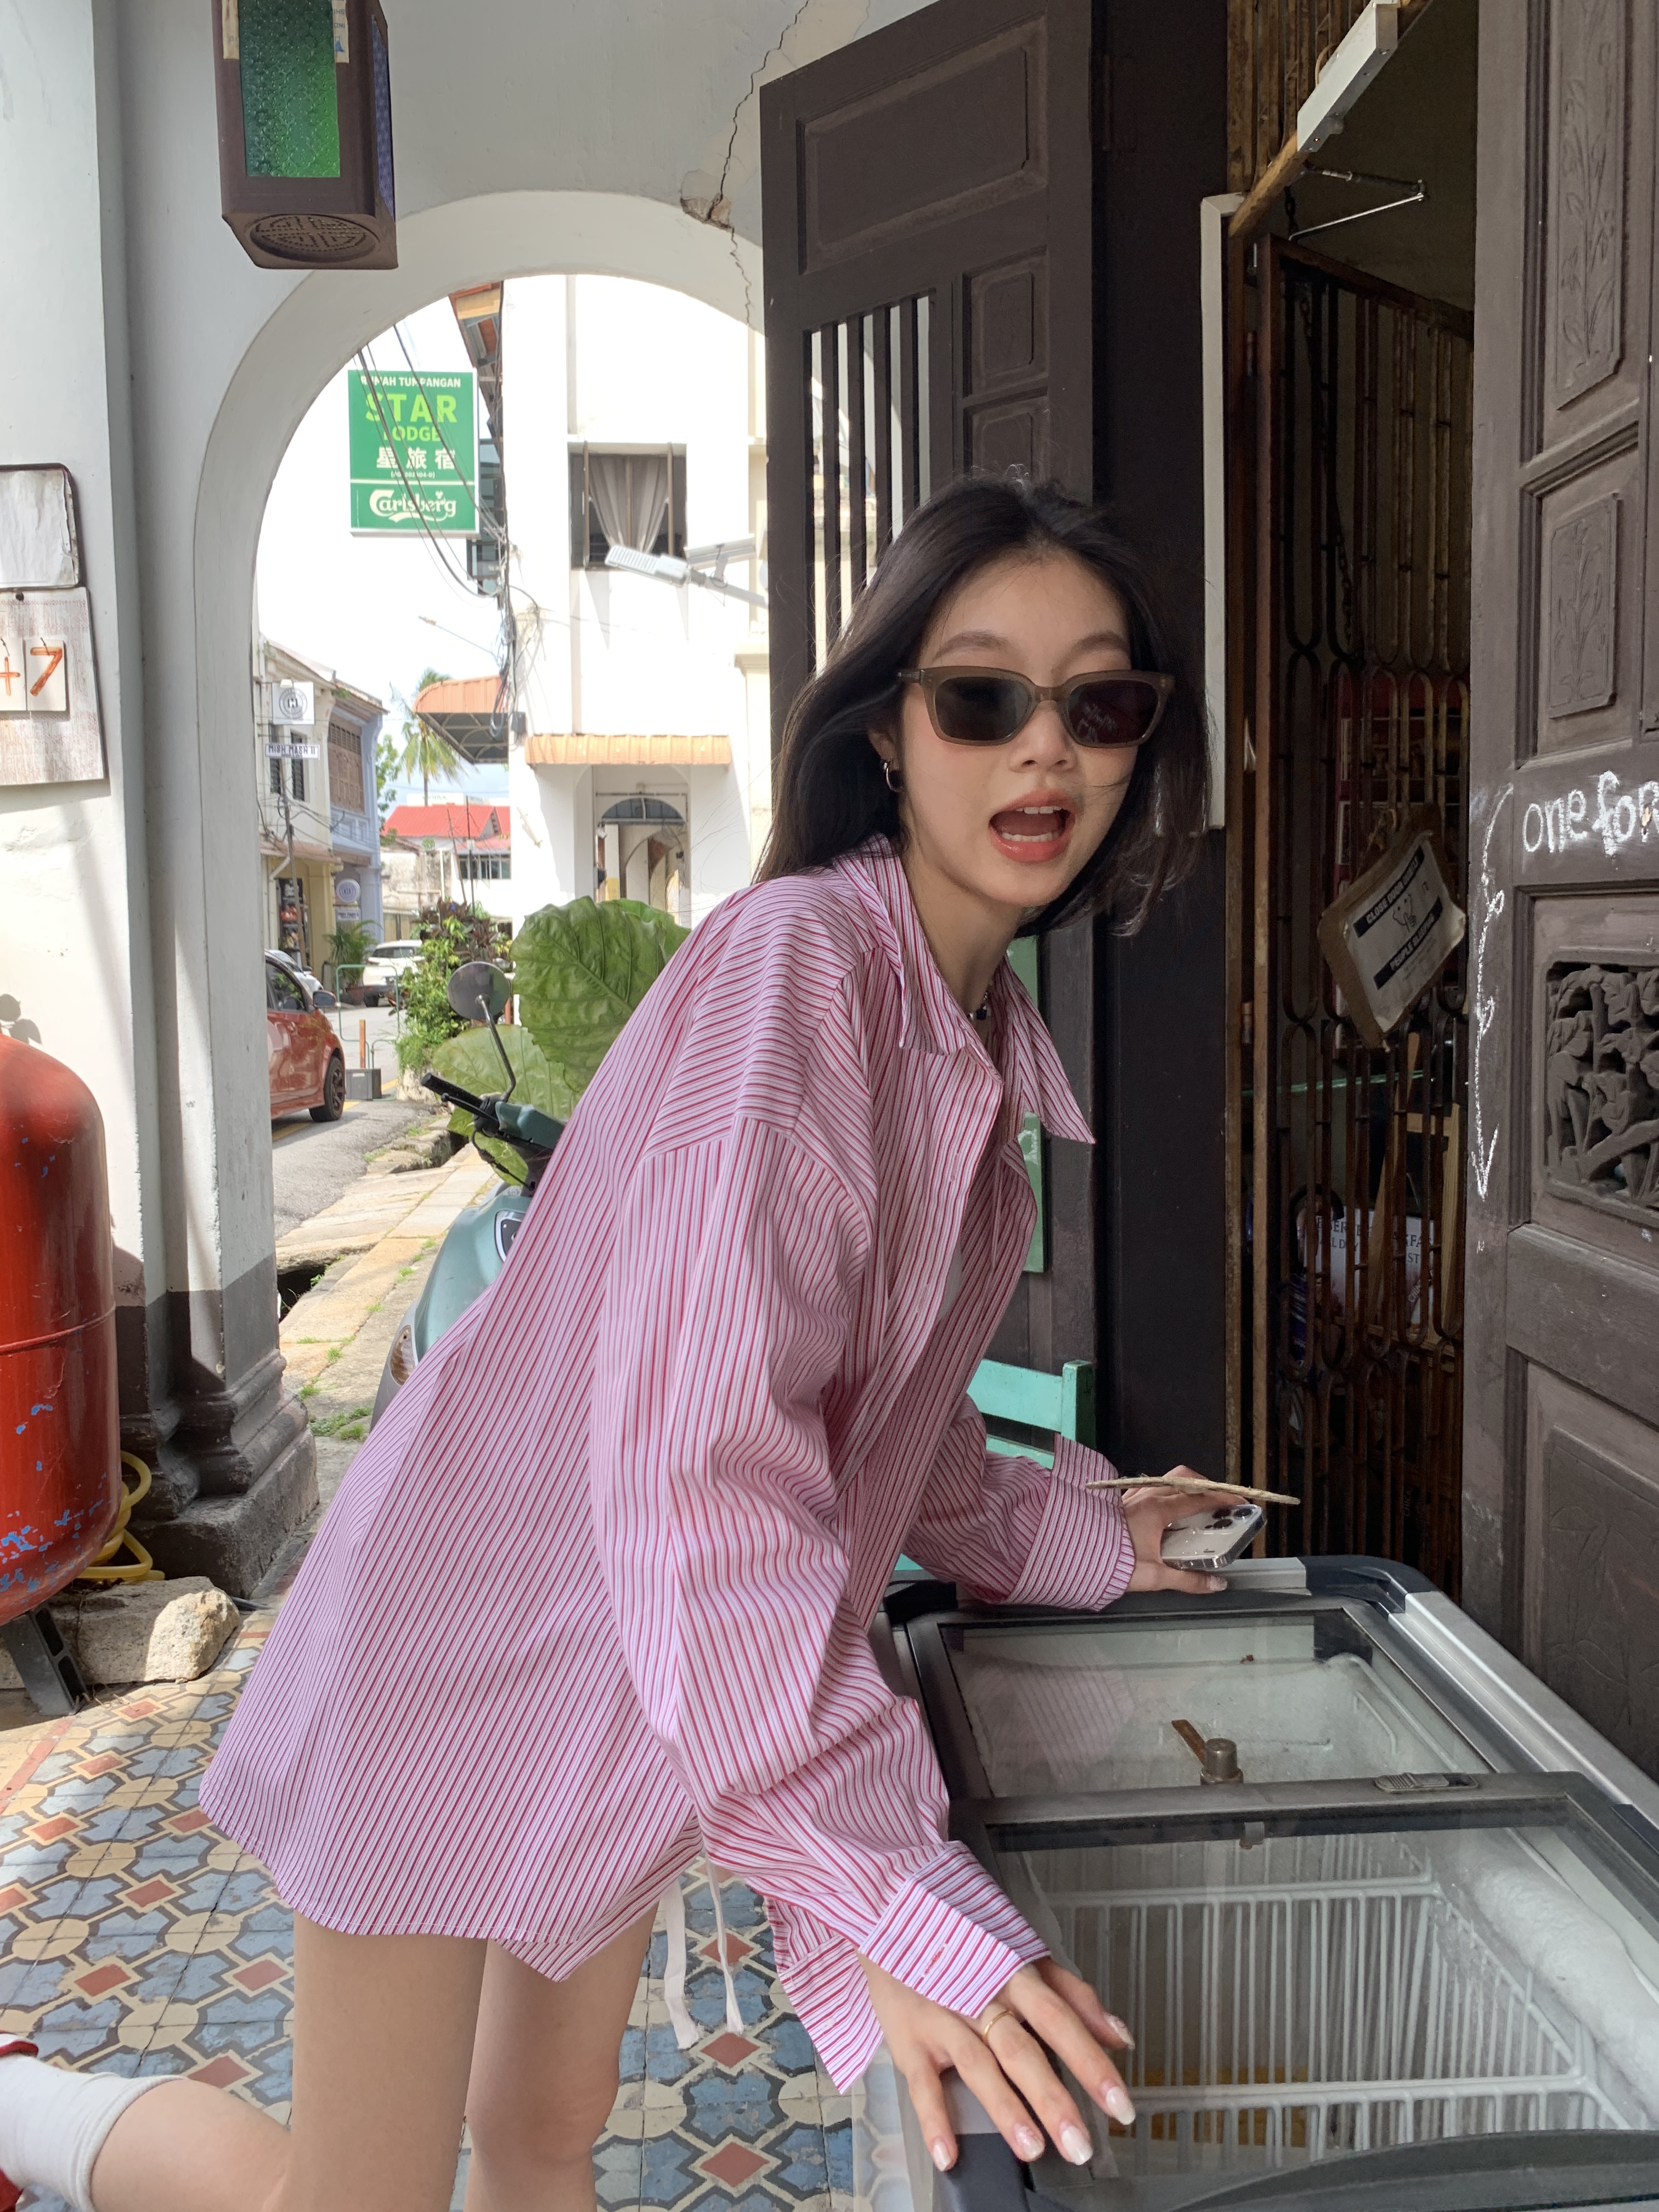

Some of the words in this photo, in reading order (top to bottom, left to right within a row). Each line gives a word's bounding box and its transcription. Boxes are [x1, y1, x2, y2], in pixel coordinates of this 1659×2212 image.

[365, 392, 458, 423] STAR
[369, 488, 456, 519] Carlsberg
[268, 744, 286, 753] MISH
[289, 745, 308, 755] MASH
[1522, 788, 1588, 853] one
